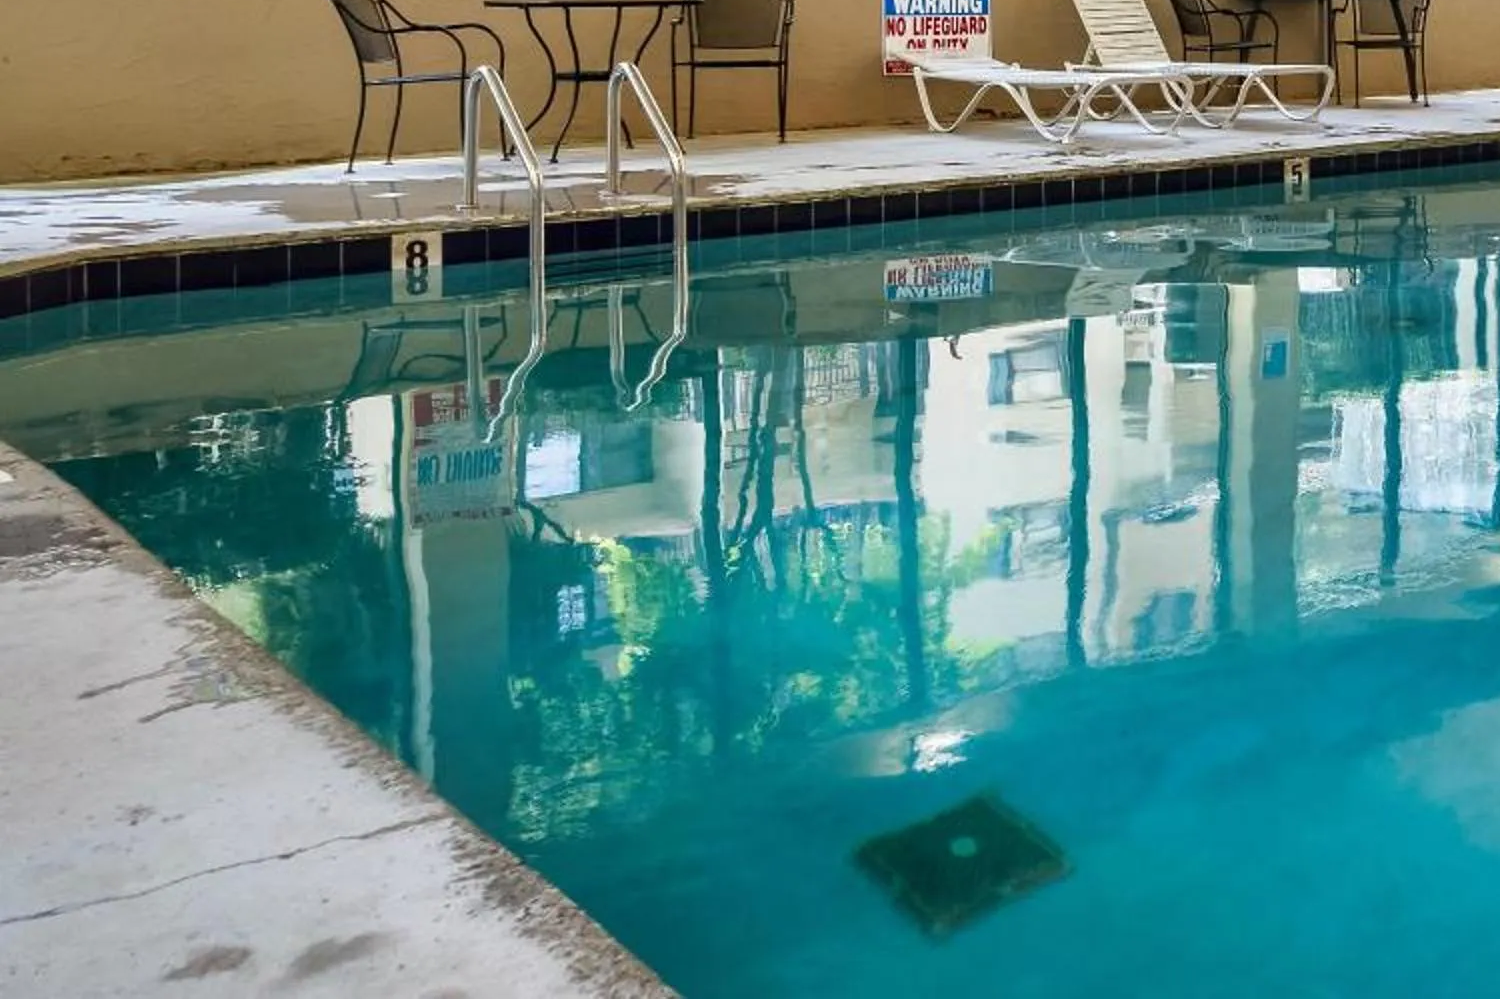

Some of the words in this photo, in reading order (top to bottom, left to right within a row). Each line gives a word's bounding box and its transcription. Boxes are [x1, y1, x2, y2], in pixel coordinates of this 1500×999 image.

[886, 17, 907, 36] NO
[913, 17, 987, 36] LIFEGUARD
[933, 38, 968, 50] DUTY
[406, 240, 429, 268] 8
